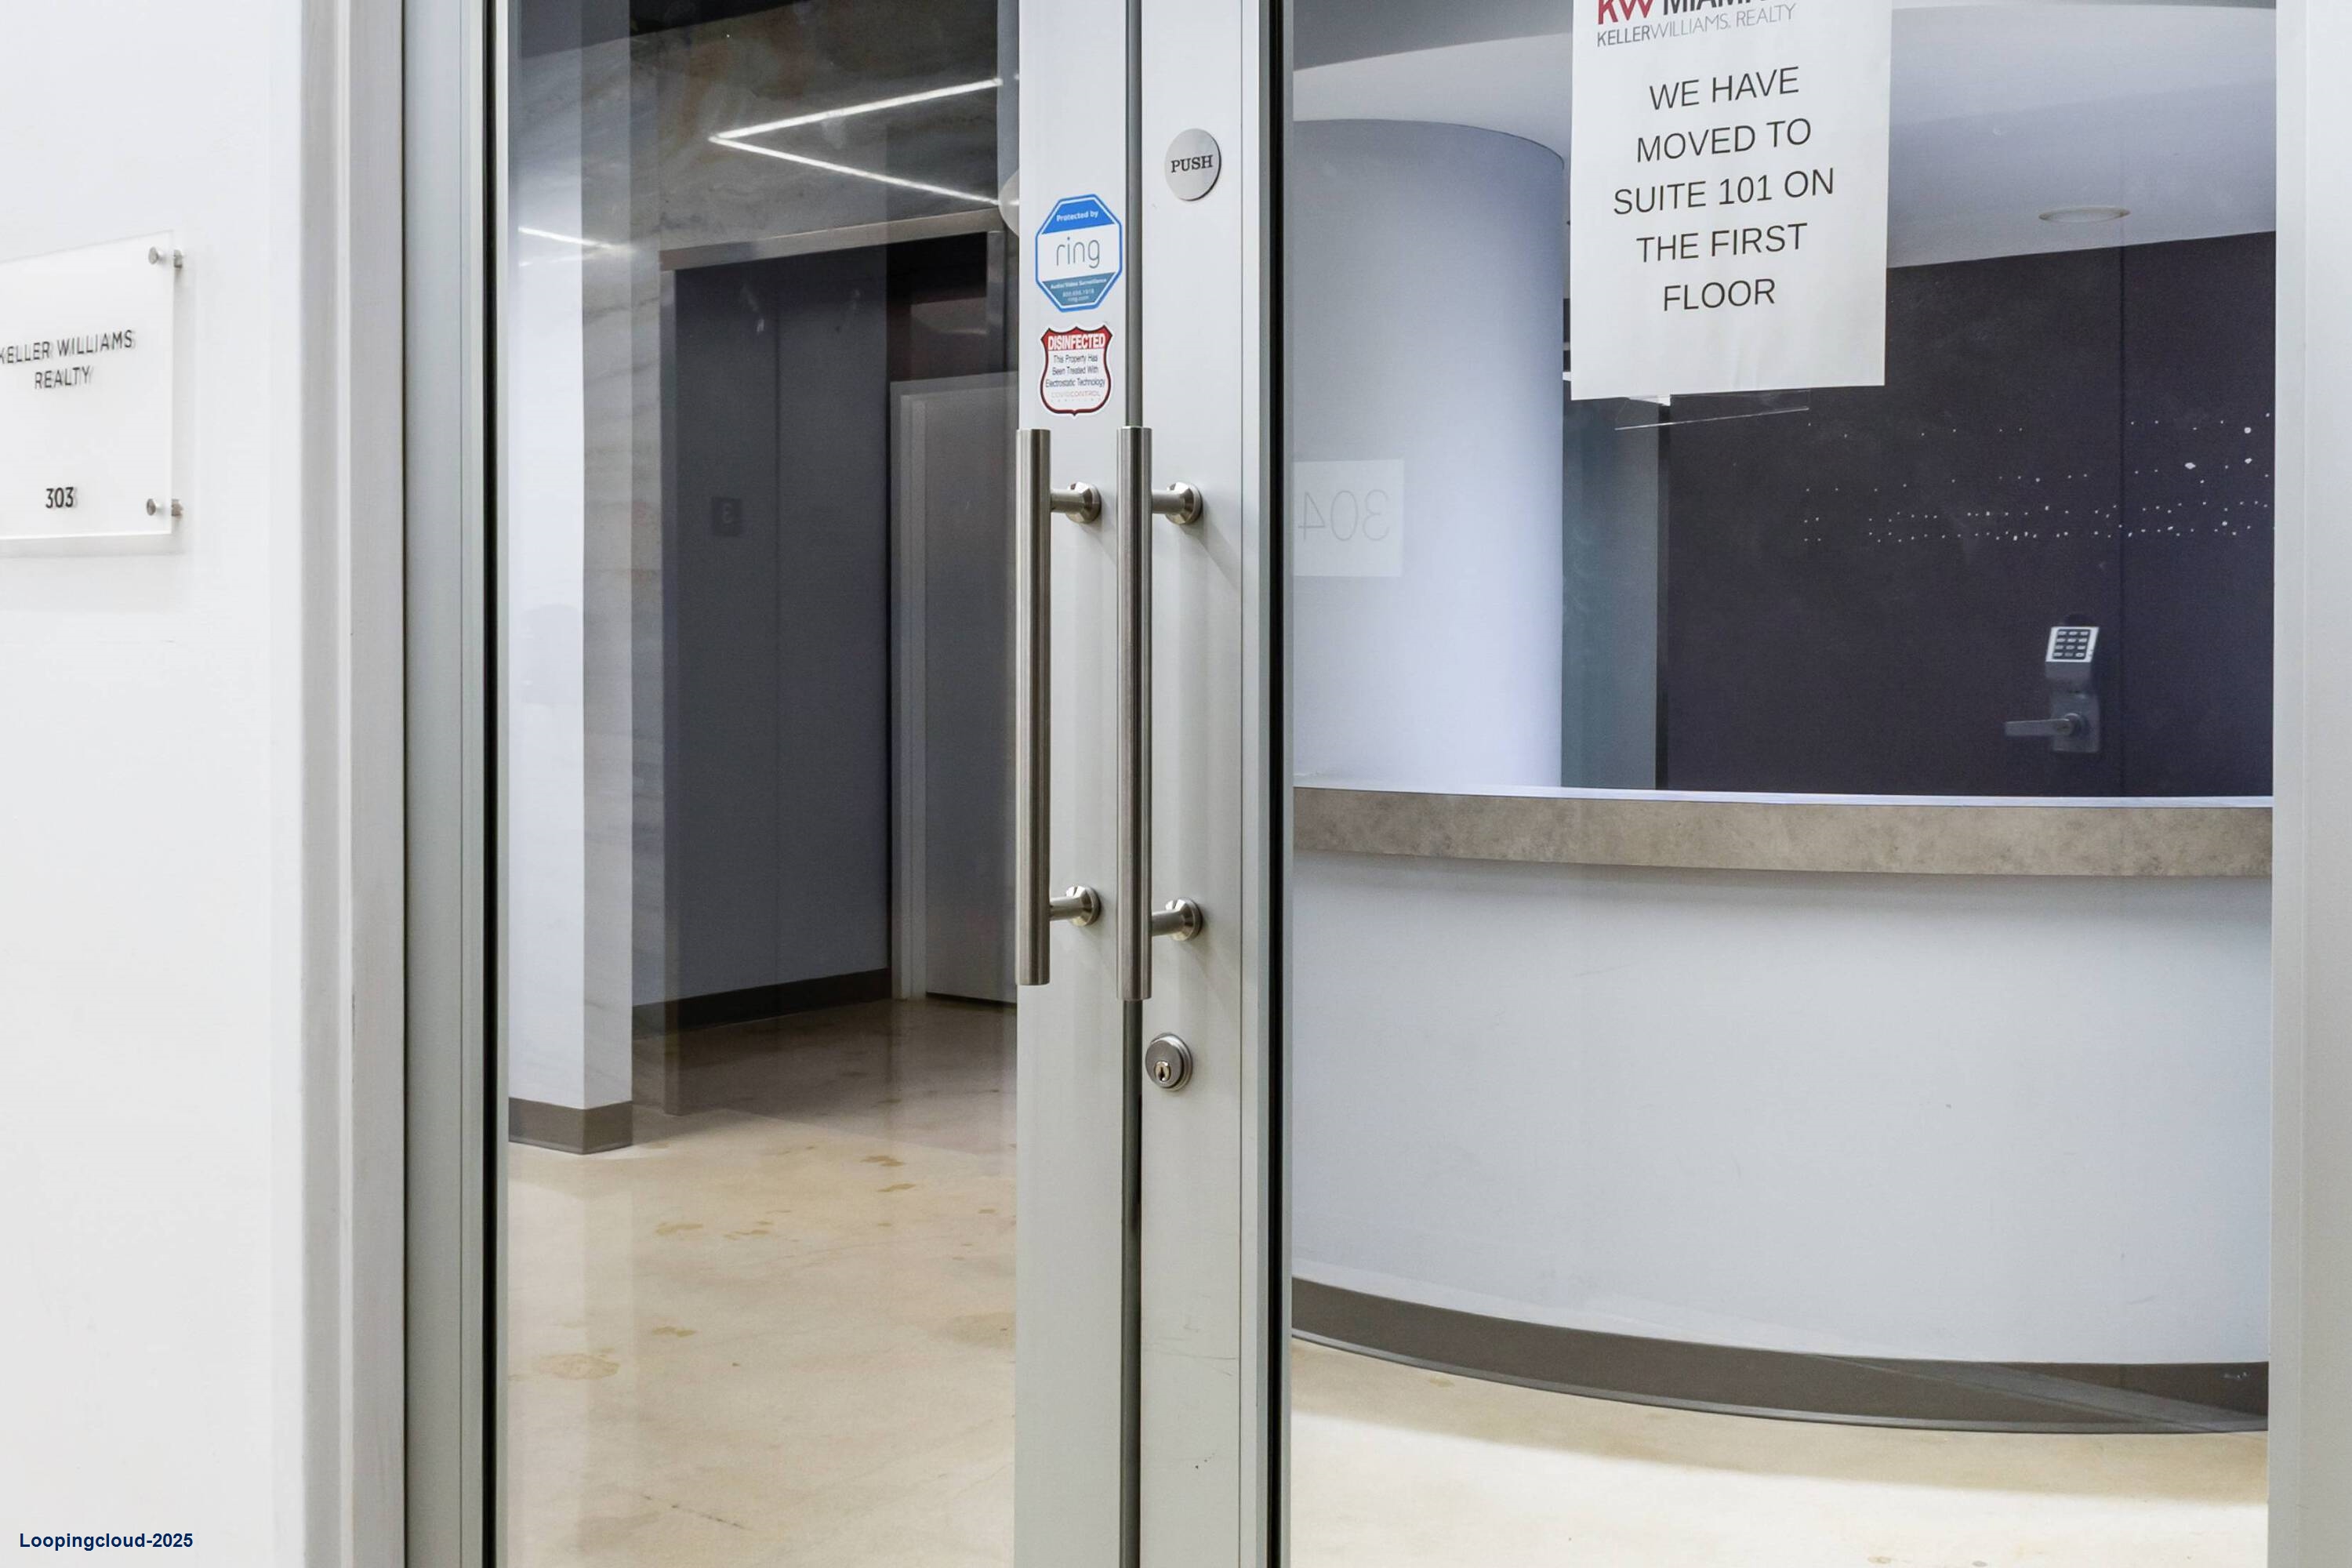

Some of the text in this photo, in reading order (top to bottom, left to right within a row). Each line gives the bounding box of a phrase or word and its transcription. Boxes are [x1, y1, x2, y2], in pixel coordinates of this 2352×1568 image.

[1736, 3, 1796, 27] REALTY
[1650, 66, 1799, 111] WE HAVE
[1637, 118, 1811, 163] MOVED TO
[1171, 154, 1214, 173] PUSH
[1613, 167, 1834, 215] SUITE 101 ON
[1056, 210, 1099, 222] Protected by
[1056, 236, 1100, 269] ring
[1636, 222, 1808, 263] THE FIRST
[1664, 278, 1776, 311] FLOOR
[56, 329, 132, 358] WILLIAMS
[1047, 333, 1106, 350] DISINFECTED
[1054, 354, 1098, 365] This Property Has
[1067, 366, 1086, 375] Treated
[35, 365, 91, 390] REALTY
[1077, 378, 1105, 388] Technology
[45, 486, 74, 509] 303
